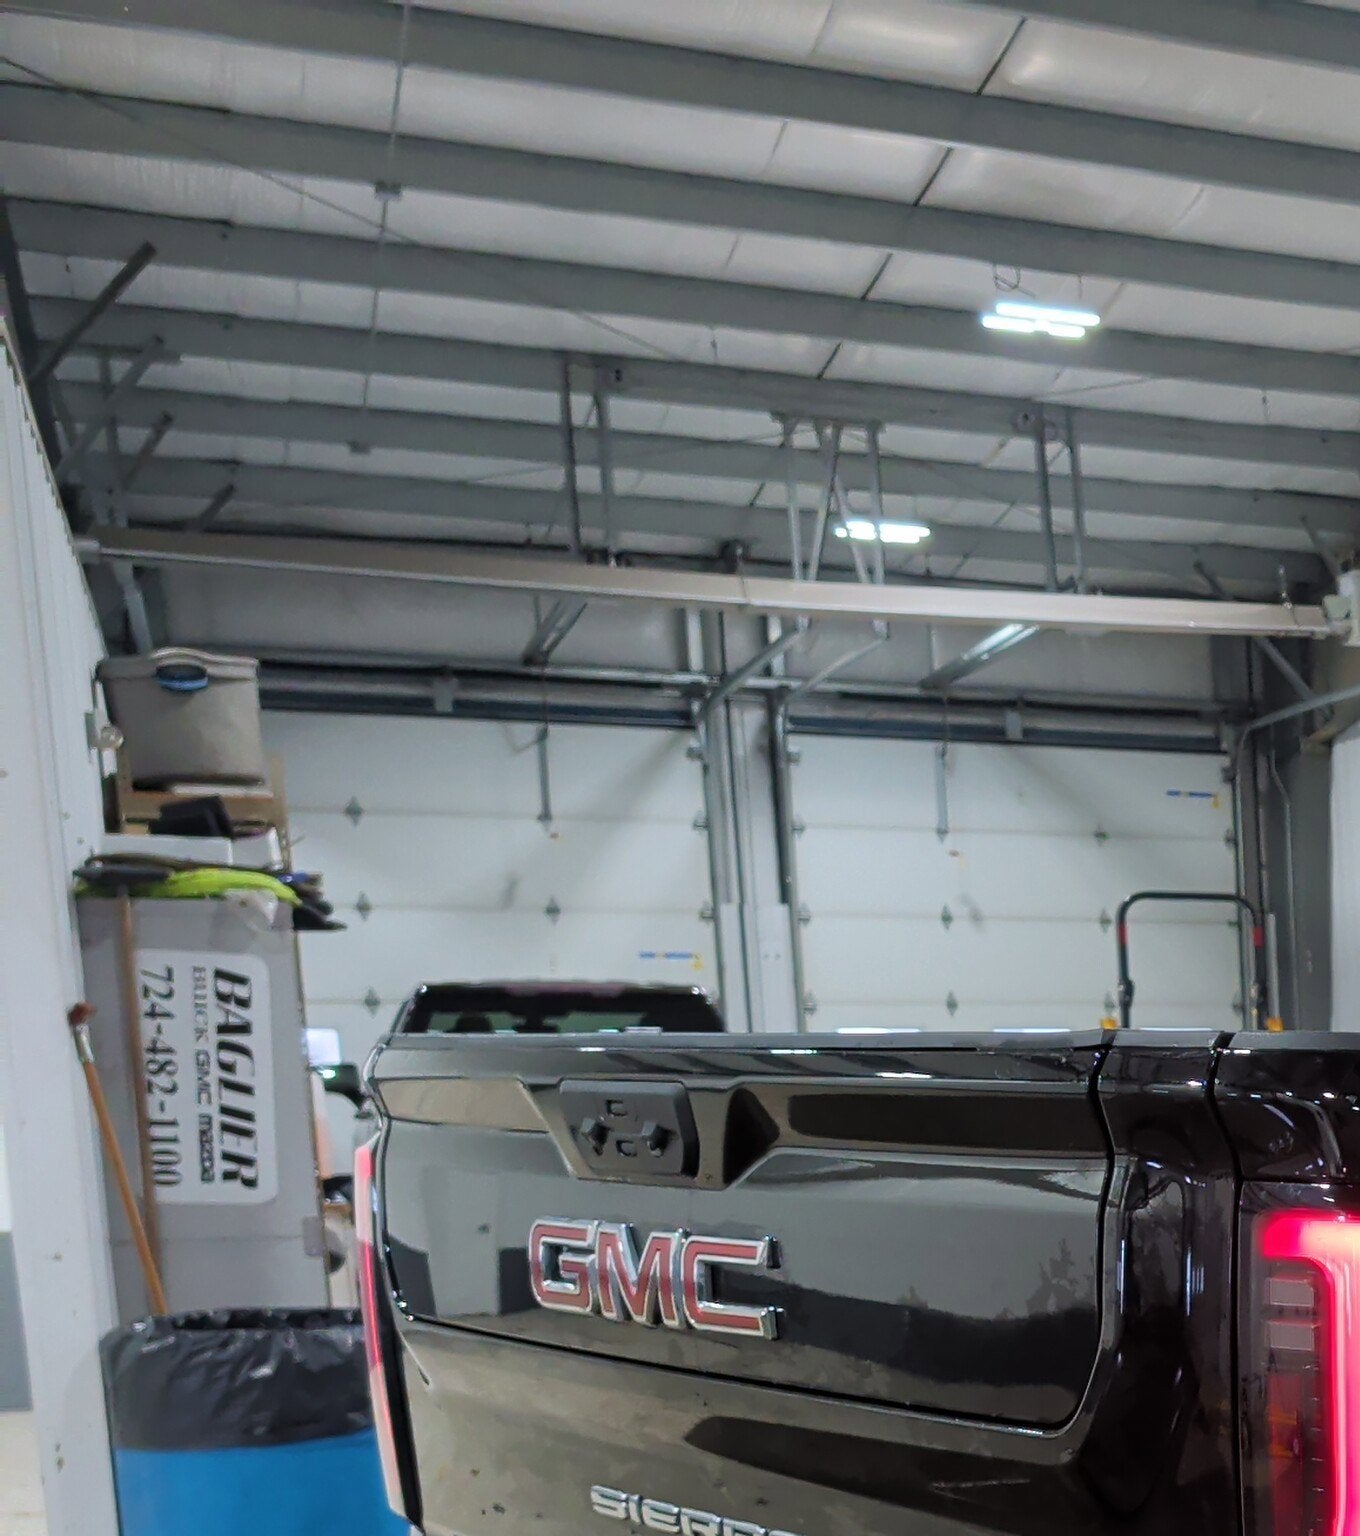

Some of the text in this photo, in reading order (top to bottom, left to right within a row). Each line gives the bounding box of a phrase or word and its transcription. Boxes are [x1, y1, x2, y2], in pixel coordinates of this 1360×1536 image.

[192, 966, 209, 1042] BUICK
[141, 965, 183, 1186] 724-482-1100
[195, 1049, 211, 1105] GMC
[214, 967, 259, 1188] BAGLIER
[529, 1215, 783, 1339] GMC
